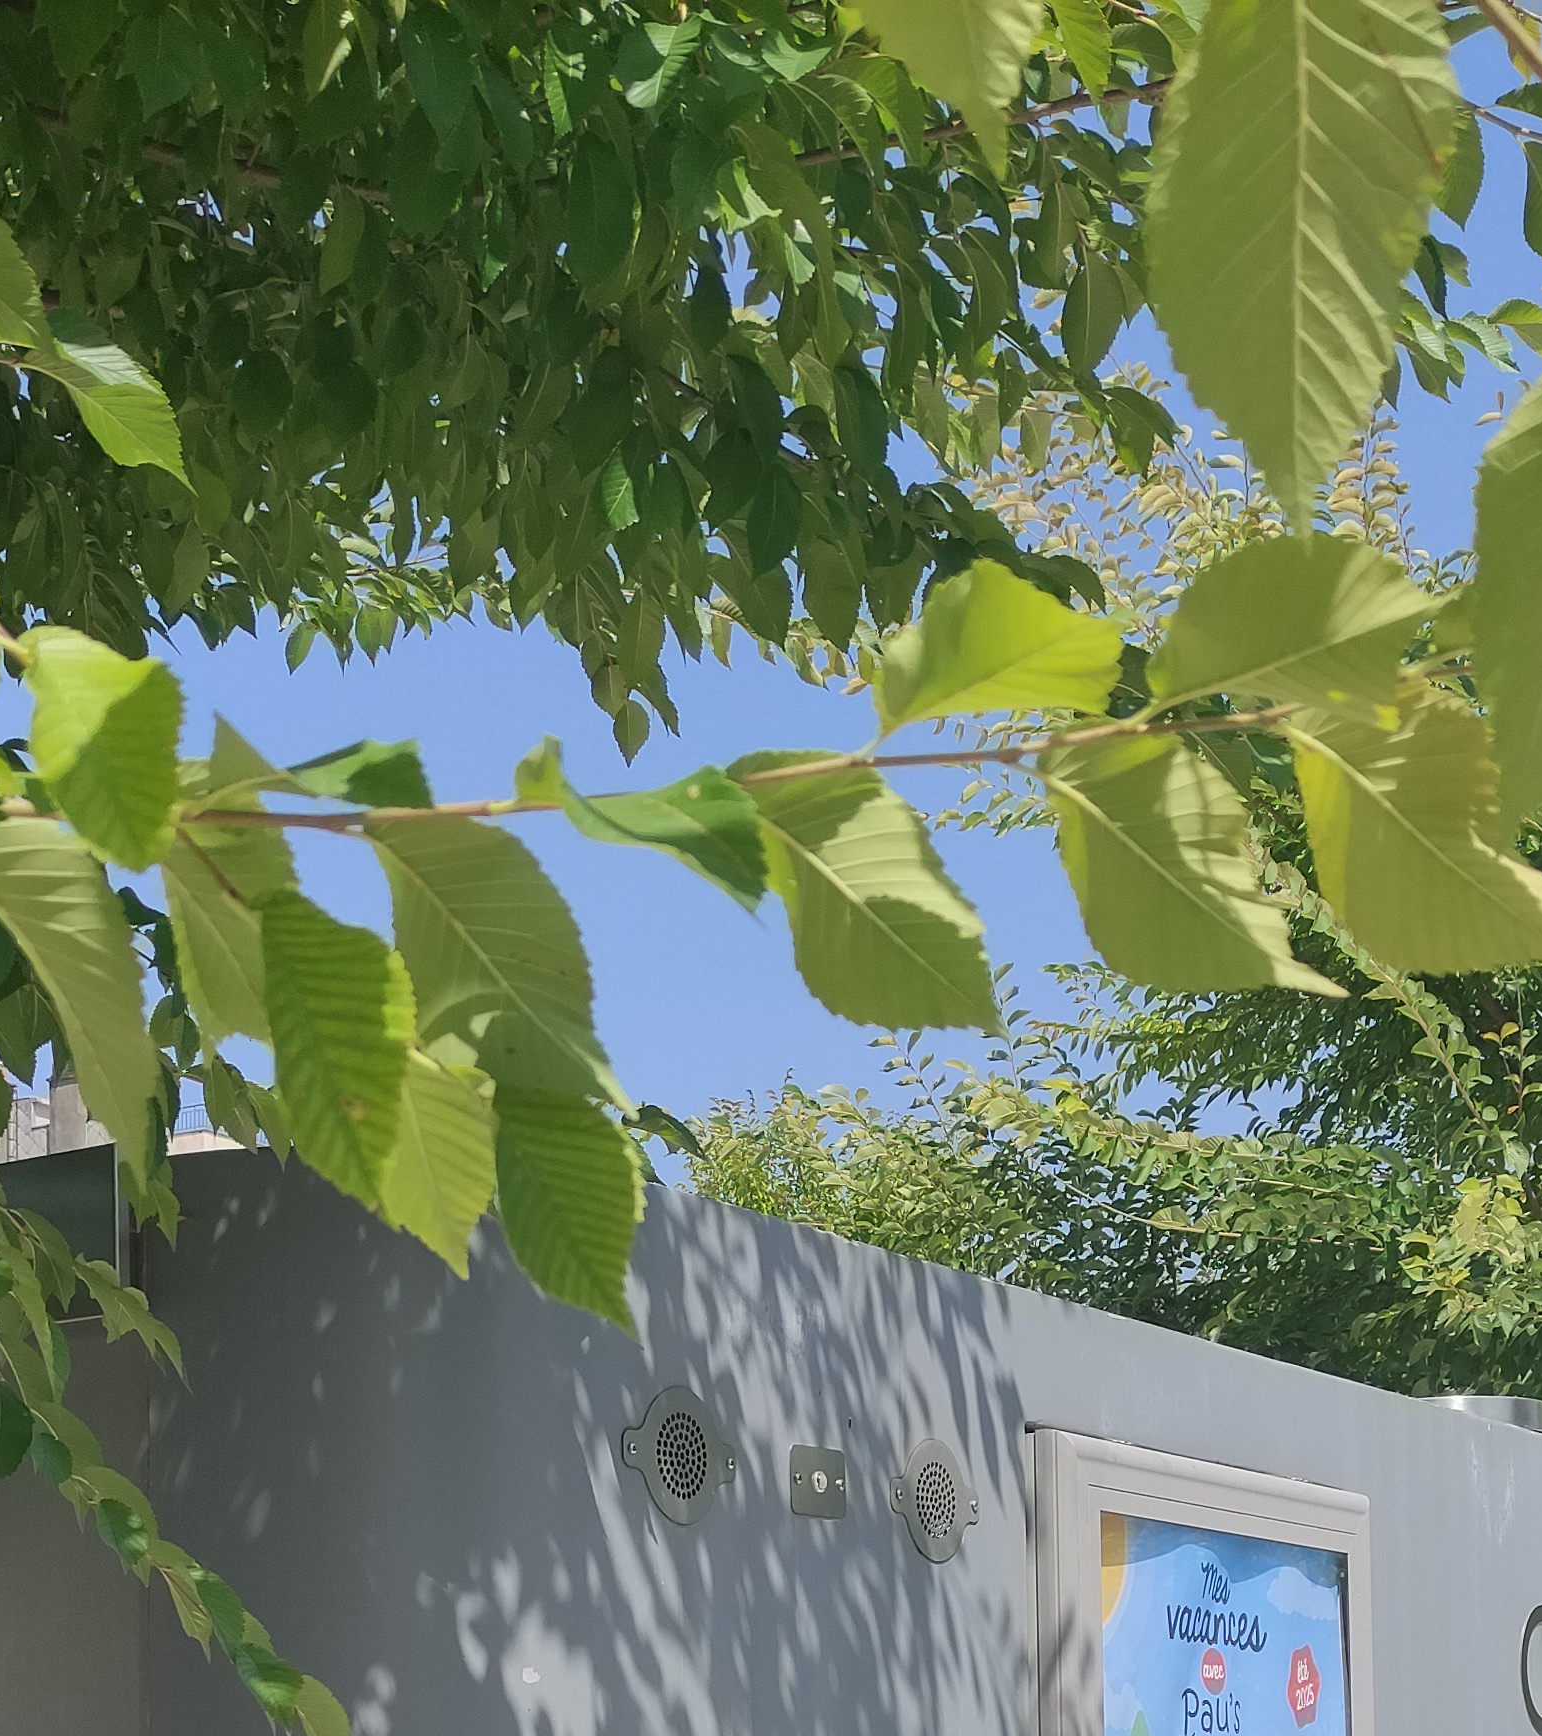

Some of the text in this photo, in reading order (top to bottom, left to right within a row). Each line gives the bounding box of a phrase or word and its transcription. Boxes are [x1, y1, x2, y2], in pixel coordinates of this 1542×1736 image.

[1201, 1561, 1231, 1605] Mes
[1167, 1604, 1268, 1653] vacances
[1202, 1664, 1226, 1680] avec
[1181, 1688, 1241, 1736] Pau's
[1296, 1683, 1315, 1711] 2025
